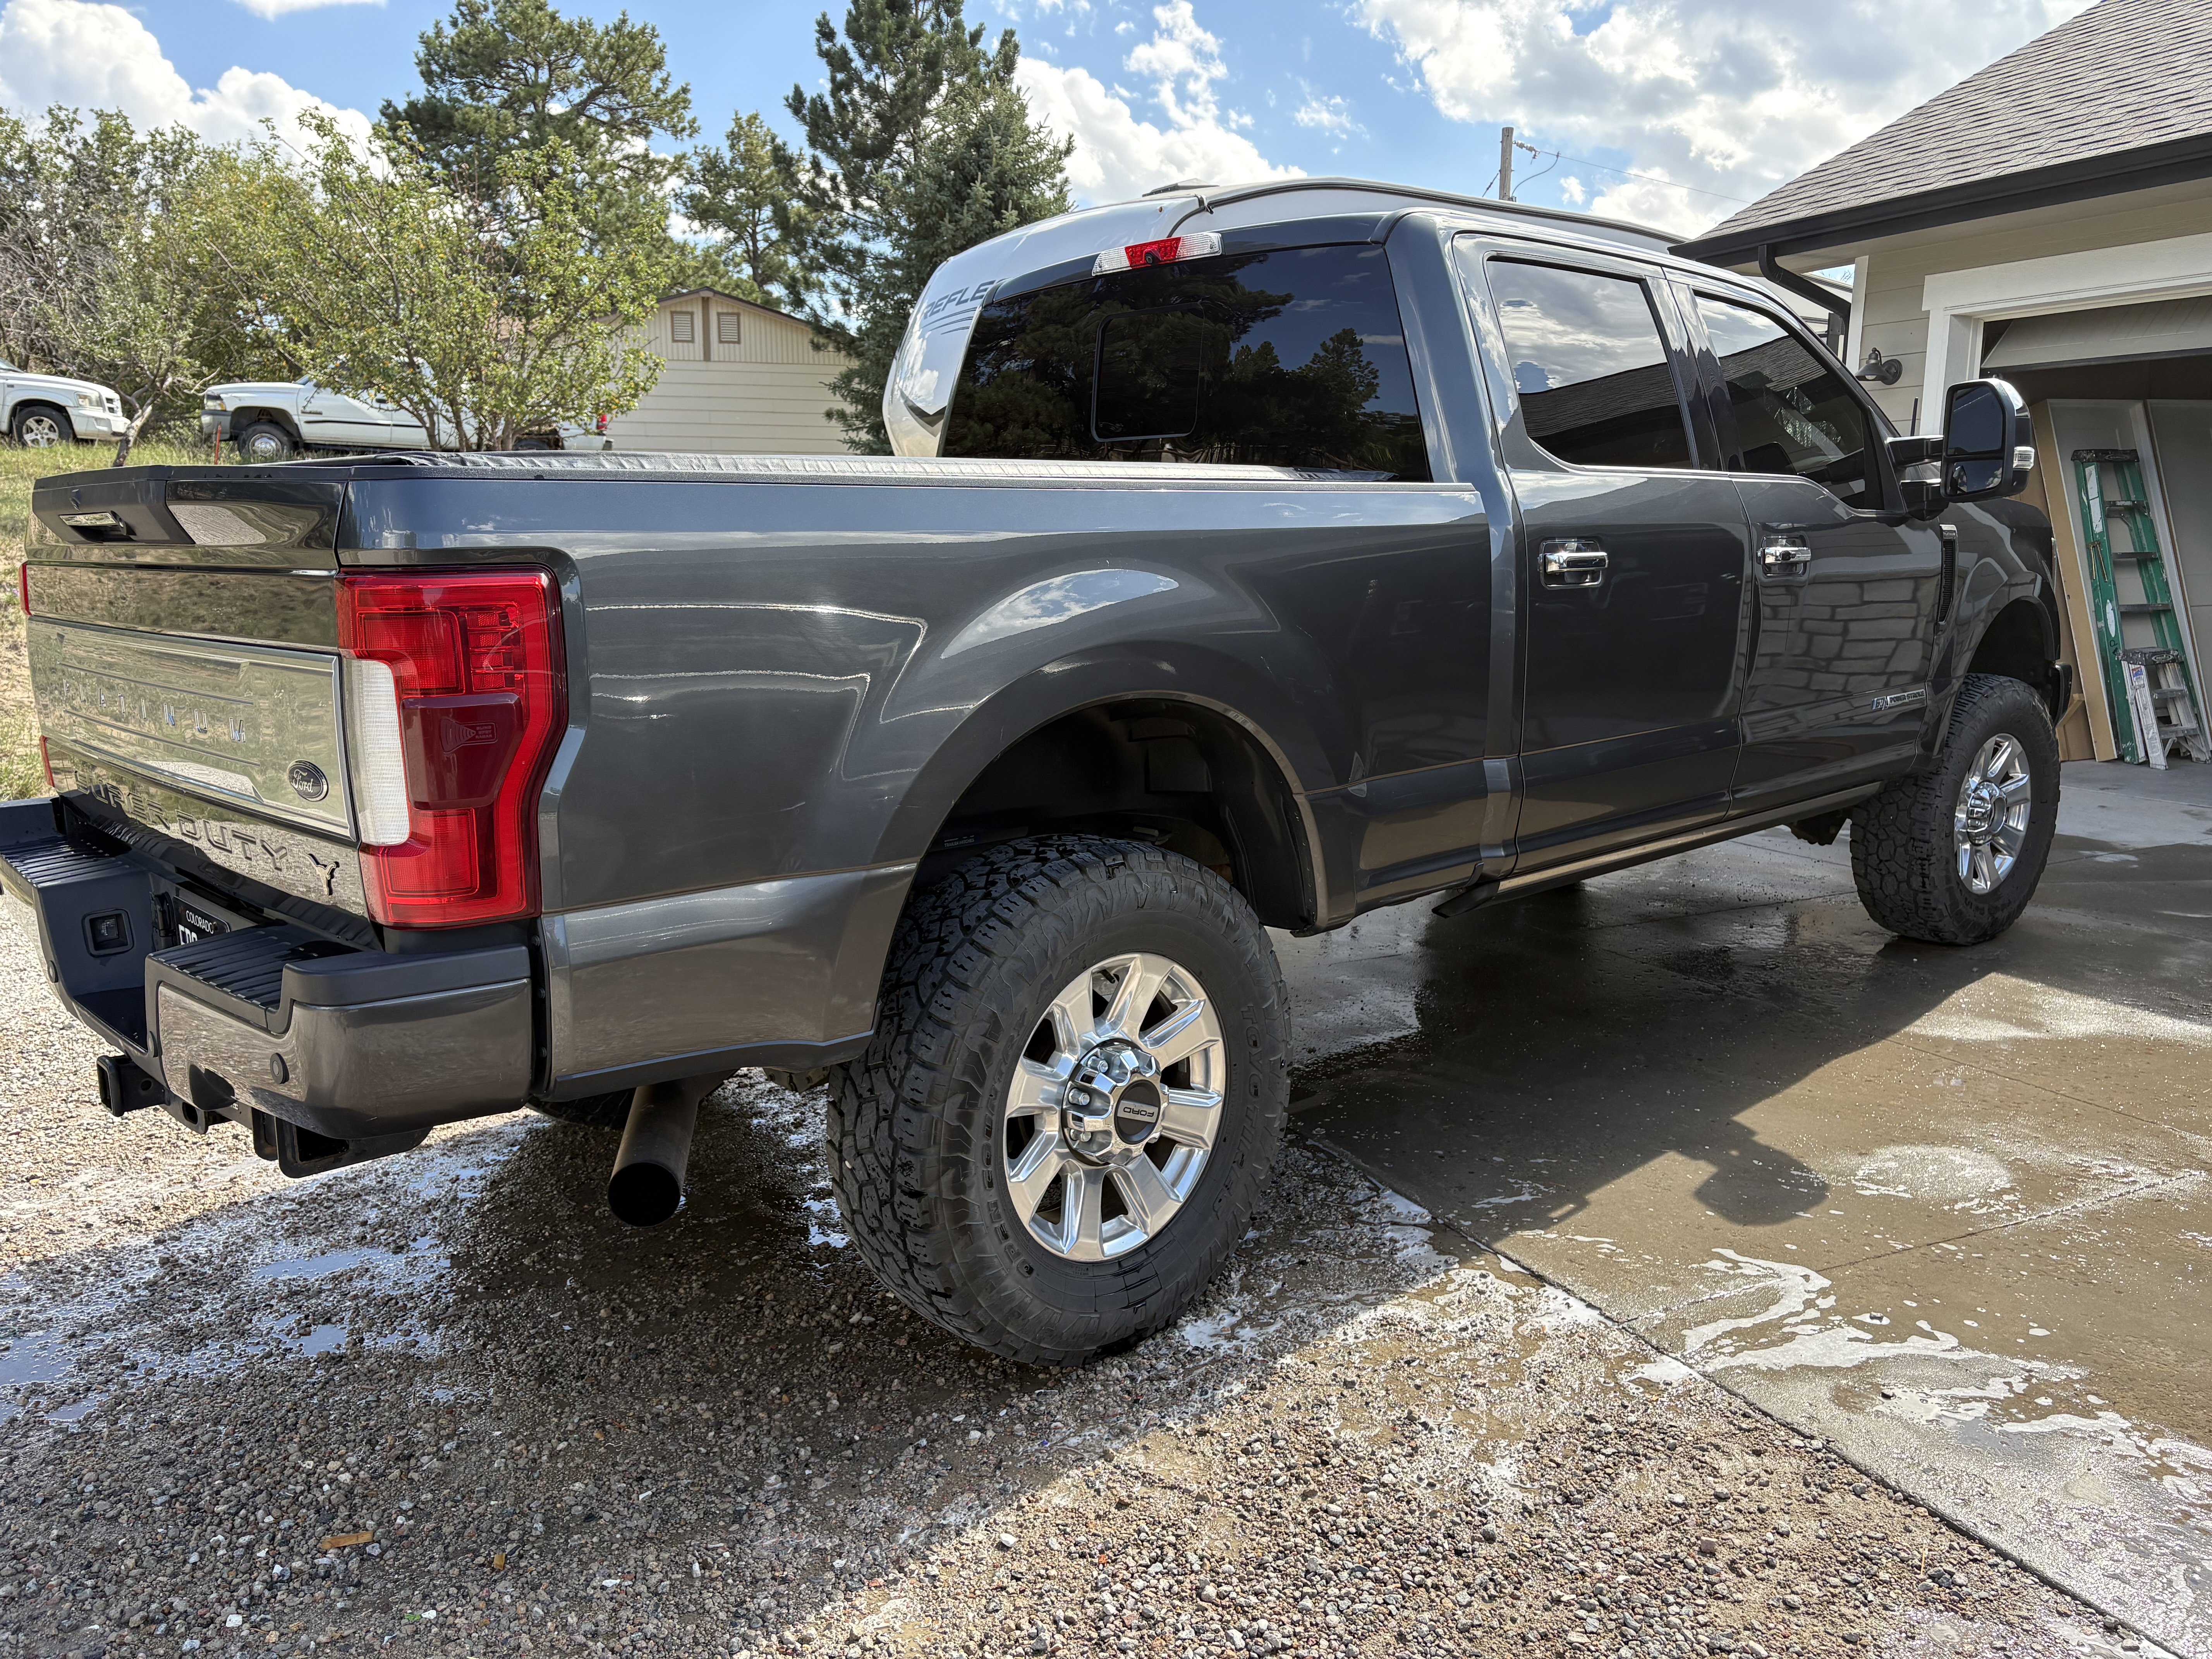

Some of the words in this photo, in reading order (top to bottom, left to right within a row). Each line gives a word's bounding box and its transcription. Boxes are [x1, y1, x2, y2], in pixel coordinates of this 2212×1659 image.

[923, 277, 1012, 319] REFLE
[63, 678, 246, 743] PLATINUM
[291, 769, 314, 793] Ford
[75, 771, 170, 830] SUPER
[175, 809, 287, 872] DUTY
[186, 910, 214, 934] COLORADO
[1241, 1005, 1262, 1099] TOYO
[1123, 1106, 1154, 1117] FORD
[1213, 1104, 1259, 1221] TIRES
[987, 1199, 1034, 1278] OPEN
